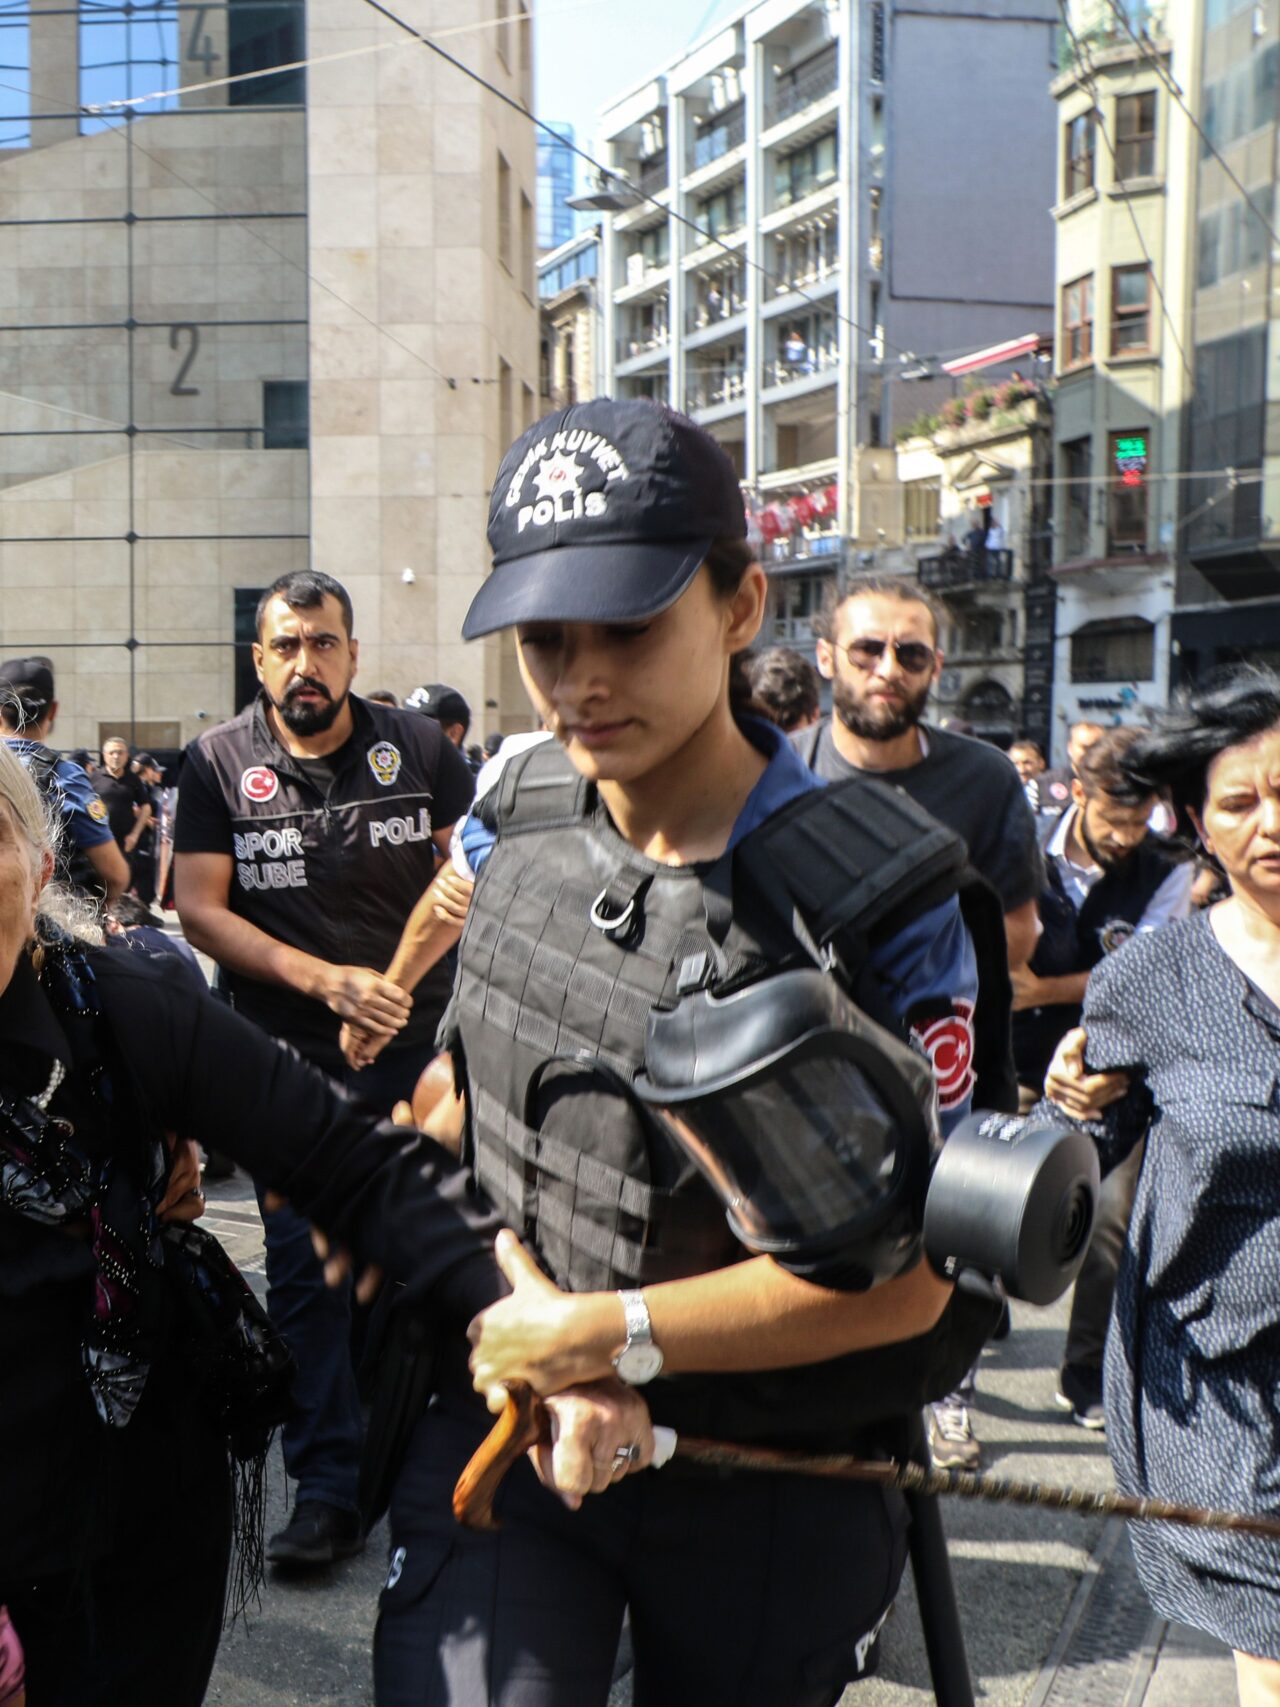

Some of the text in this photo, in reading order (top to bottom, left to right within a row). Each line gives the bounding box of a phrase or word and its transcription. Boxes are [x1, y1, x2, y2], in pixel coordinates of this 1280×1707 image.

[187, 6, 220, 77] 4
[169, 324, 200, 396] 2
[550, 429, 630, 481] KUVVET
[233, 827, 305, 861] SPOR
[237, 859, 309, 892] ŞUBE
